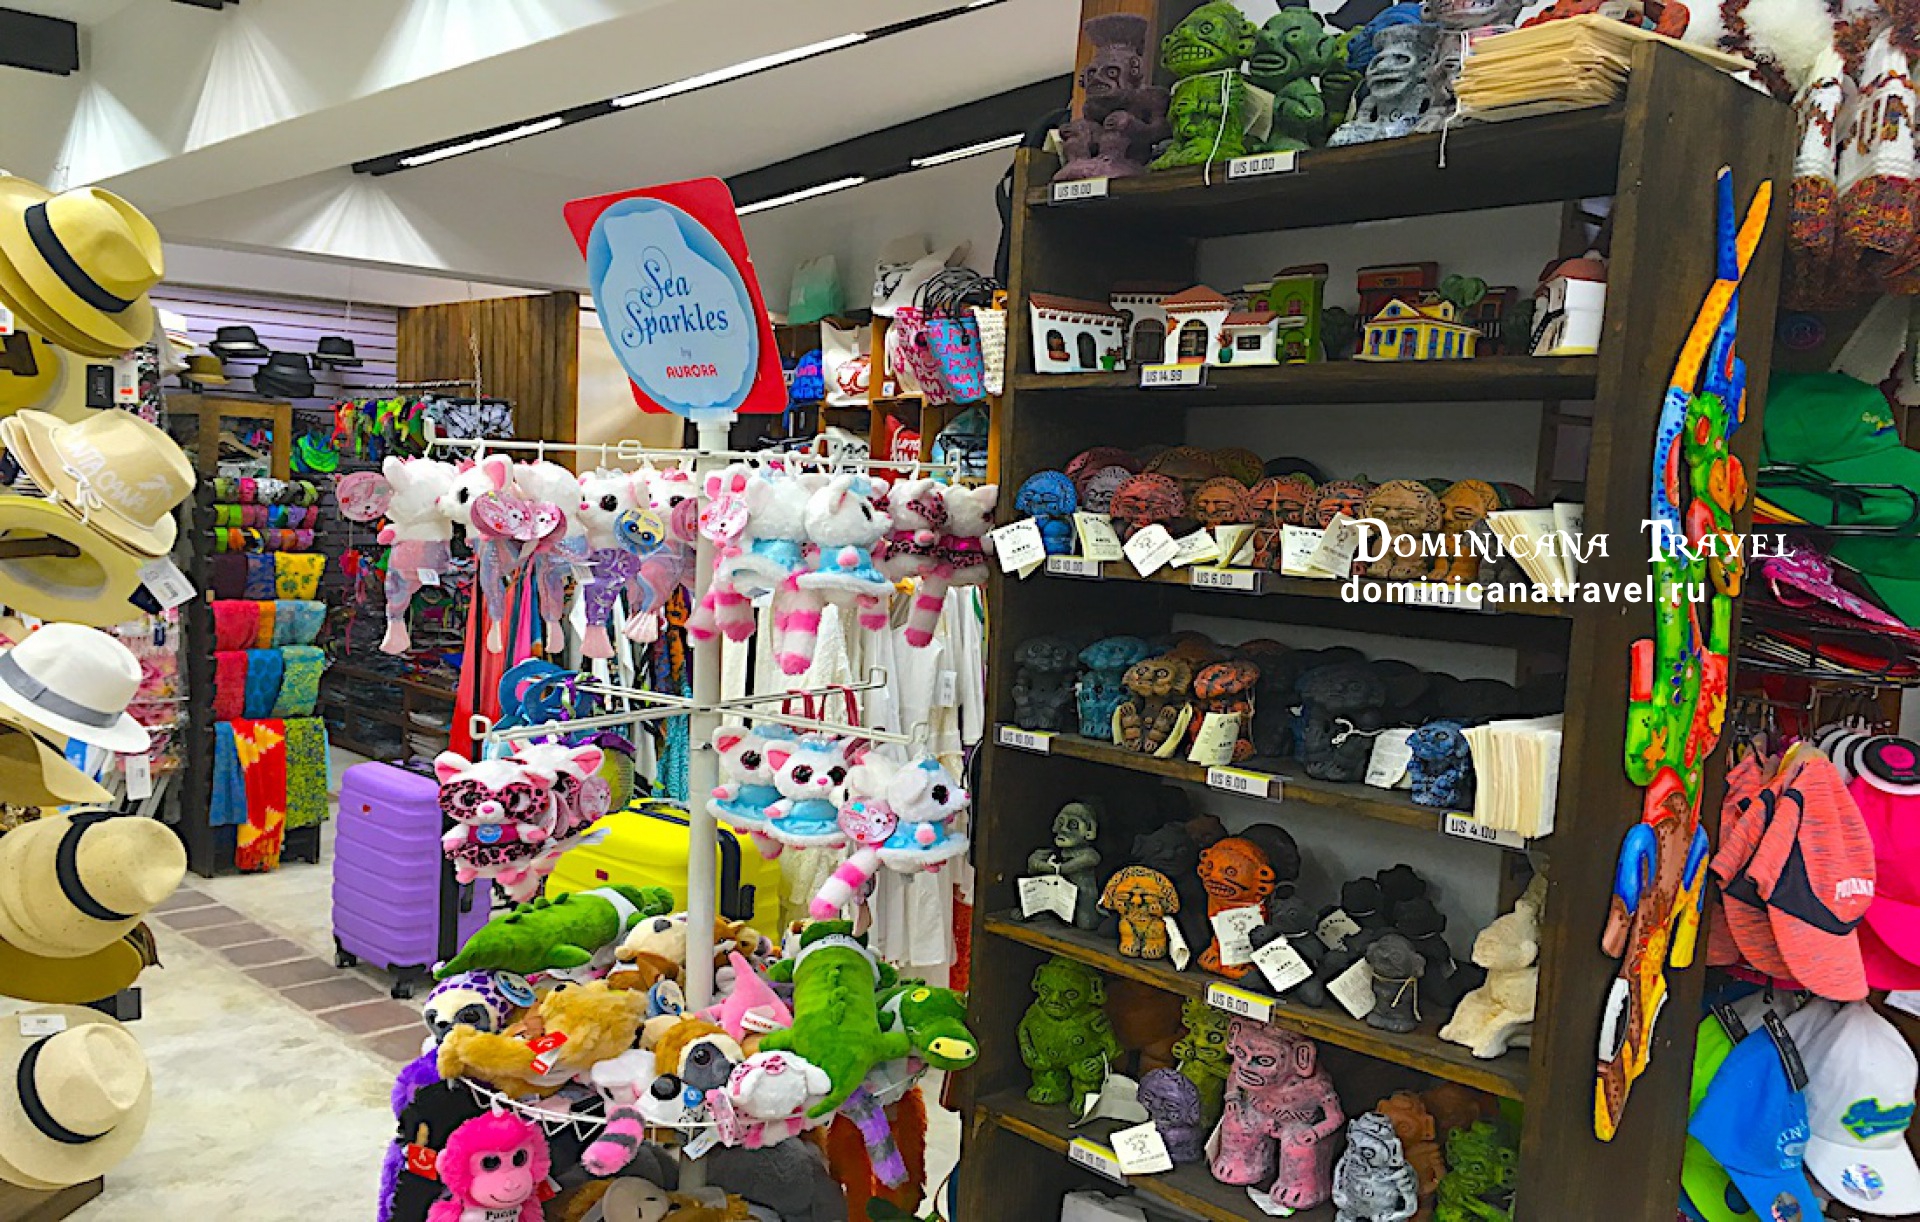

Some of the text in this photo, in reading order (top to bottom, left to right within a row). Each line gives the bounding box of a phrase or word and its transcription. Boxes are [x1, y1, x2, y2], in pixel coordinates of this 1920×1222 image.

[1234, 157, 1275, 174] US 10.00
[1057, 184, 1069, 198] US
[639, 247, 693, 308] Sea
[621, 299, 729, 348] Sparkles
[666, 362, 718, 379] AURORA
[1146, 369, 1158, 383] US
[1050, 559, 1061, 570] US
[1196, 572, 1233, 585] US 6.00
[1003, 730, 1013, 743] US
[1210, 772, 1247, 790] US 6.00
[1451, 819, 1467, 834] US
[1212, 991, 1249, 1013] US 6.00
[1073, 1146, 1085, 1160] US
